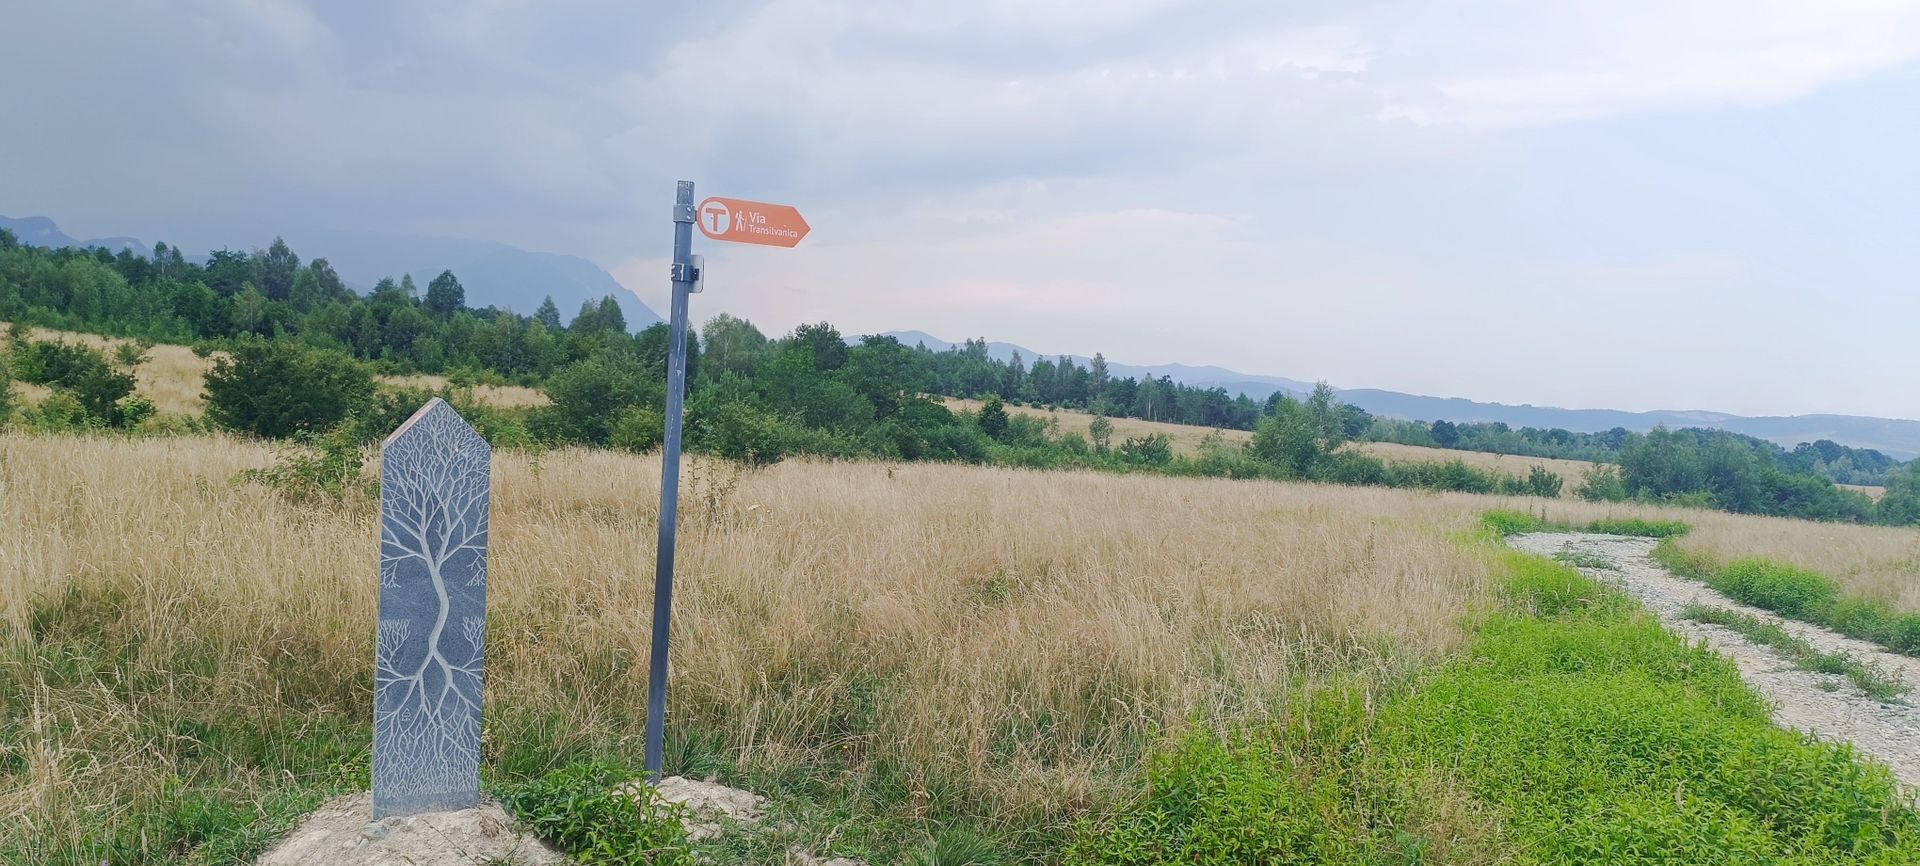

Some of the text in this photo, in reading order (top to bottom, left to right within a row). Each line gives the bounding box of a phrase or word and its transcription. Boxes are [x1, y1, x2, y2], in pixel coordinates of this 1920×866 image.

[706, 208, 726, 232] T
[749, 211, 766, 224] Via
[749, 224, 798, 238] Transilvanica
